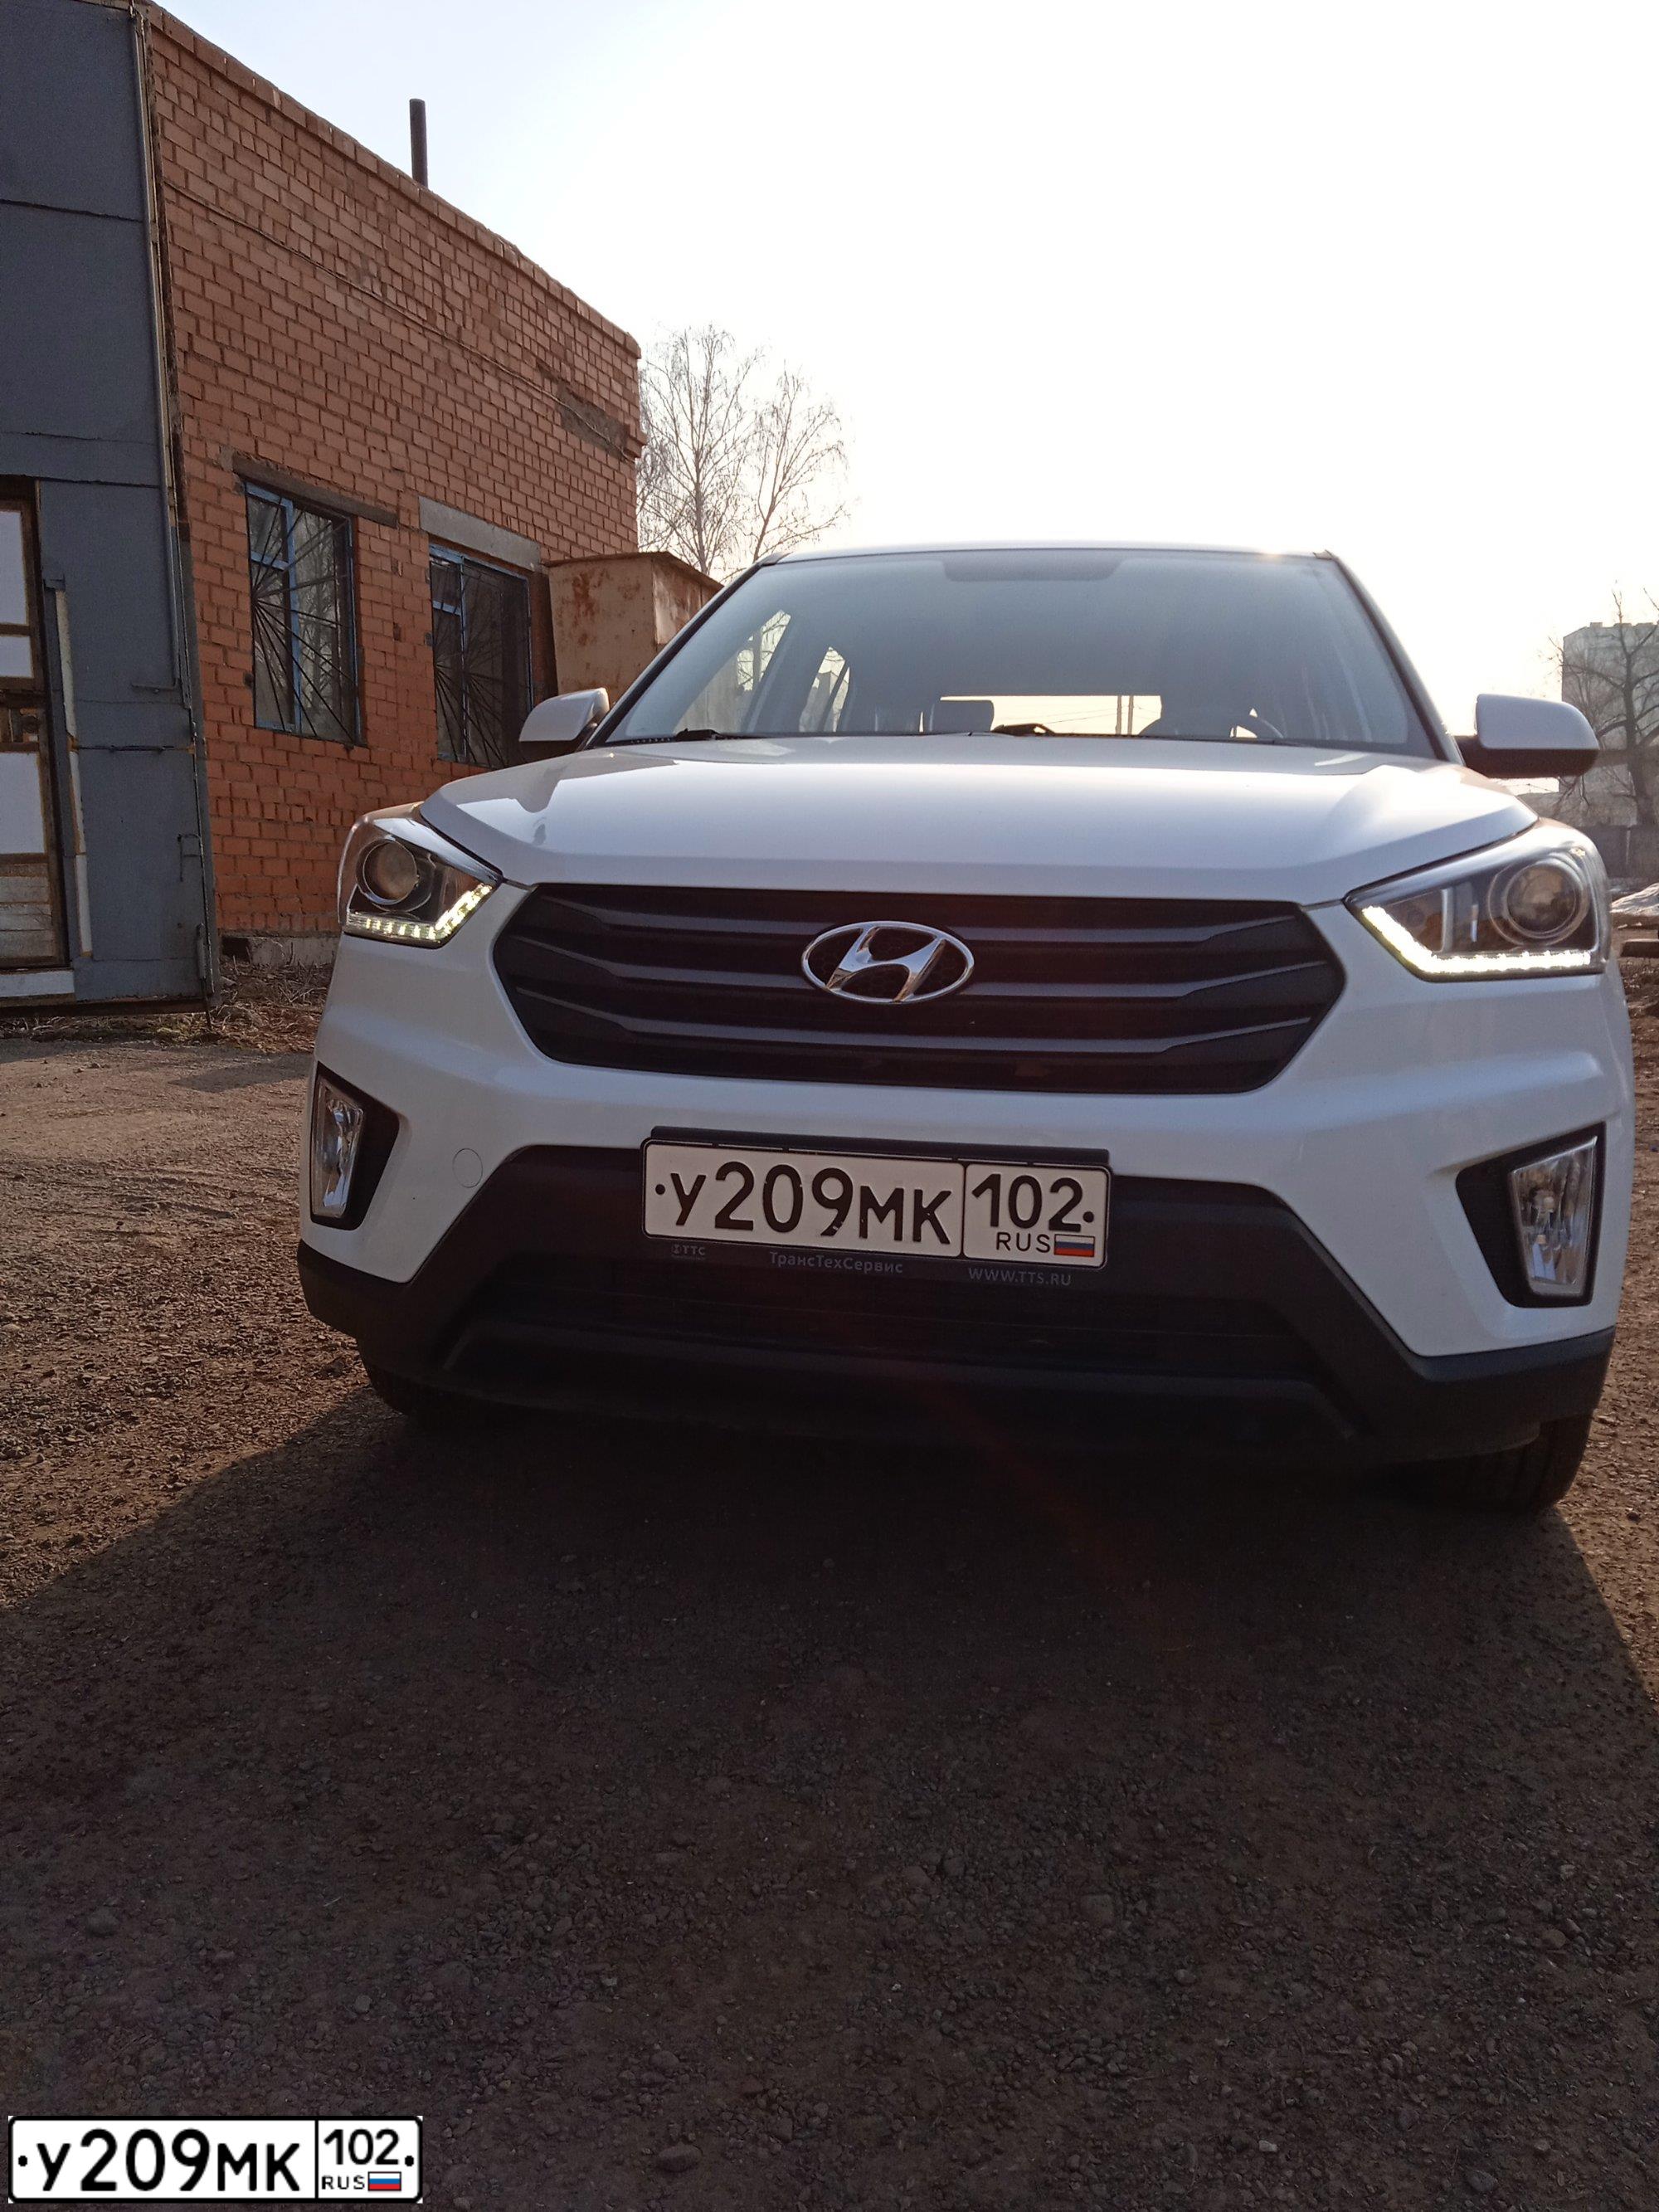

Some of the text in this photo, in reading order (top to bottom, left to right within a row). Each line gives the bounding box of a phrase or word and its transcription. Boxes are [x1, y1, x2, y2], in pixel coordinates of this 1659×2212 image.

[670, 1161, 1083, 1245] У209МК 102
[996, 1232, 1051, 1254] RUS
[769, 1251, 903, 1274] ТрансТехСервис
[968, 1267, 1072, 1286] WWW.TTS.RU
